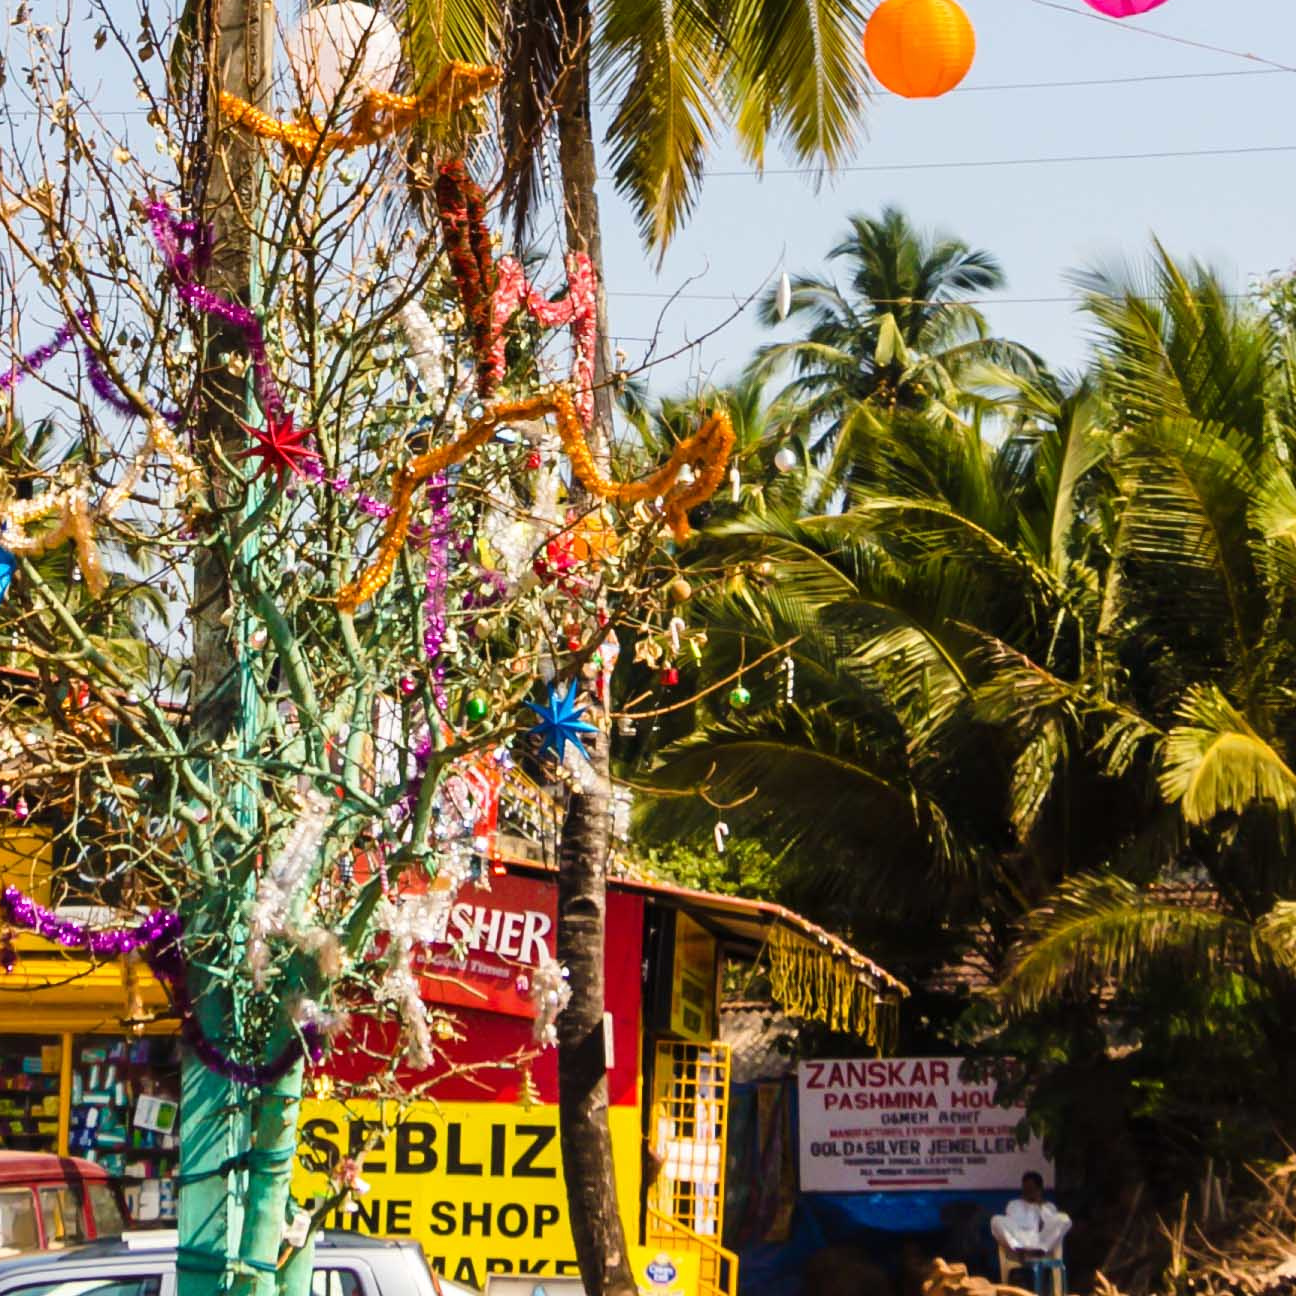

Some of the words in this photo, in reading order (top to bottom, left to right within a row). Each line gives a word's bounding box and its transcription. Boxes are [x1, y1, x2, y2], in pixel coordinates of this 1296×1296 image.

[432, 902, 554, 968] ISHER
[806, 1060, 949, 1089] ZANSKAR
[824, 1092, 937, 1111] PASHMINA
[301, 1117, 558, 1178] SEBLIZ
[429, 1201, 560, 1239] SHOP
